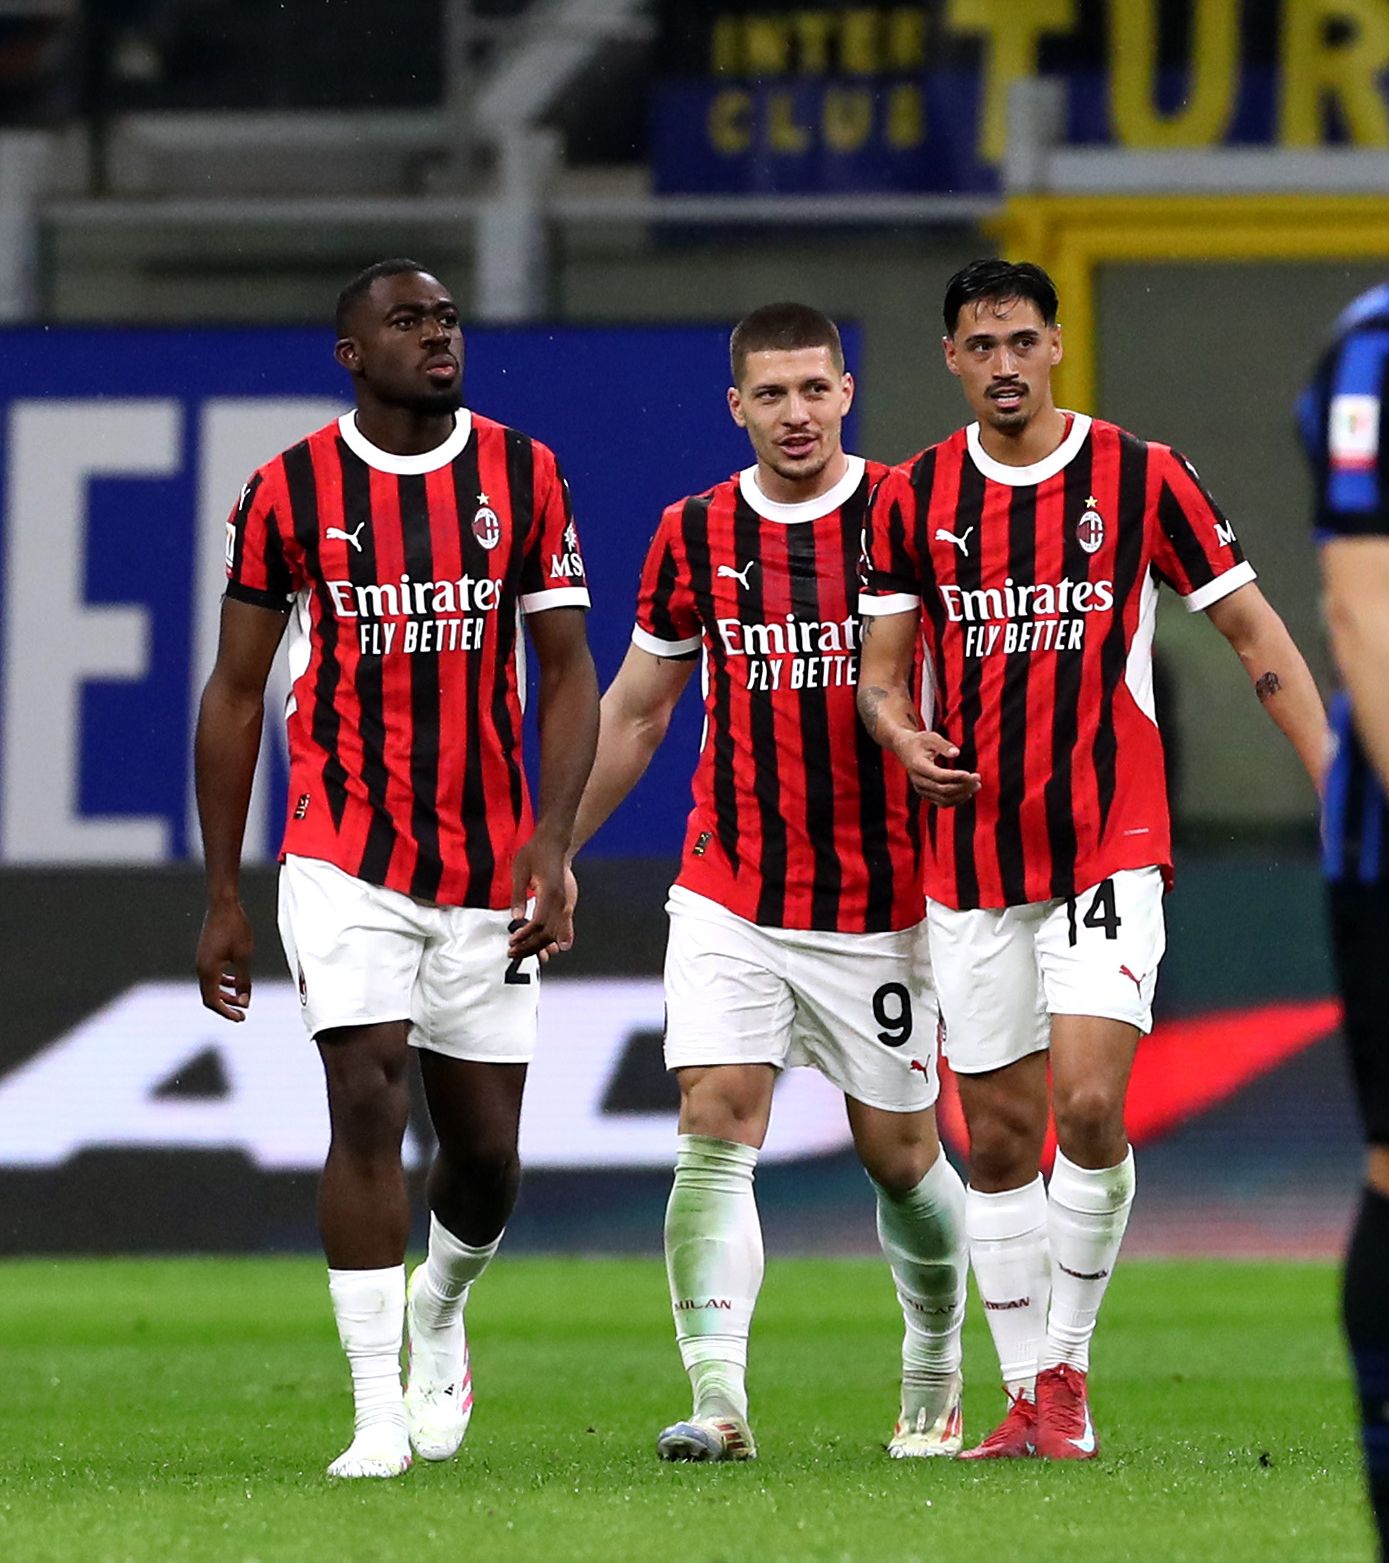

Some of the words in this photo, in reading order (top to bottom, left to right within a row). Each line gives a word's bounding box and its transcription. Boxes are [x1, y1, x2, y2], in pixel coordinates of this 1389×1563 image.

[326, 574, 503, 617] Emirates
[939, 577, 1114, 622] Emirates
[360, 622, 396, 655] FLY
[403, 617, 484, 654] BETTER
[717, 613, 864, 655] Emirat
[965, 624, 1001, 658] FLY
[1003, 618, 1085, 655] BETTER
[747, 656, 784, 690] FLY
[790, 655, 857, 690] BETTE
[1066, 878, 1122, 948] 14
[872, 982, 913, 1048] 9
